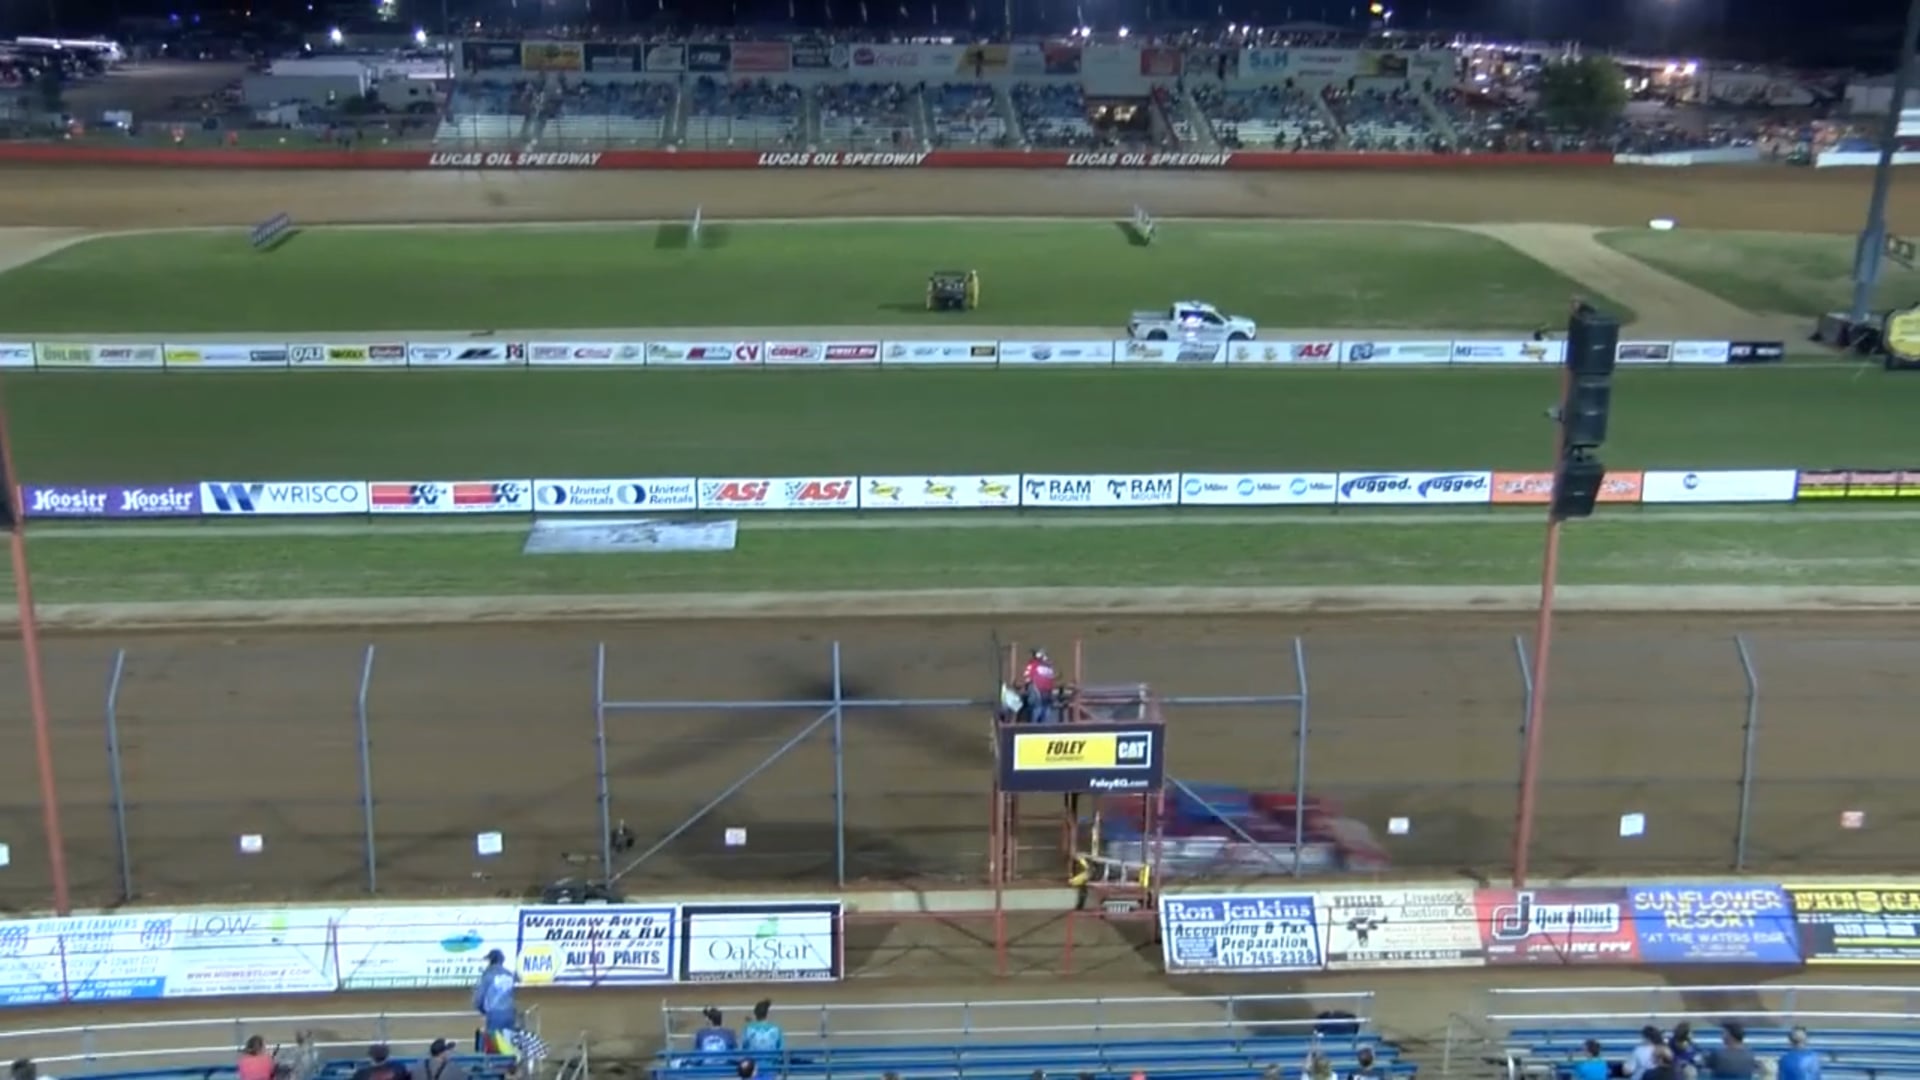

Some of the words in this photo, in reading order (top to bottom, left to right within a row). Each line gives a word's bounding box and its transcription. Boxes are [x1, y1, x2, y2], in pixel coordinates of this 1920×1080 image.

[429, 153, 482, 165] LUCAS
[486, 153, 512, 165] OIL
[517, 152, 601, 165] SPEEDWAY
[758, 153, 809, 165] LUCAS
[813, 153, 839, 165] OIL
[843, 152, 926, 165] SPEEDWAY
[1067, 153, 1118, 165] LUCAS
[1121, 153, 1145, 165] OIL
[1150, 153, 1231, 165] SPEEDWAY
[736, 345, 758, 360] CV
[268, 484, 359, 503] WRISCO
[570, 484, 611, 496] United
[649, 484, 689, 495] United
[1050, 480, 1092, 494] RAM
[1131, 479, 1172, 493] RAM
[33, 489, 107, 510] Hoosier
[121, 488, 193, 510] Hoosier
[570, 495, 614, 506] Rentals
[649, 494, 693, 505] Rentals
[1046, 741, 1086, 754] FOLEY
[1118, 741, 1146, 759] CAT
[1403, 892, 1465, 907] Livestock
[1634, 889, 1784, 911] SUNFLOWER
[1167, 902, 1214, 920] Ron
[1222, 899, 1311, 924] Jenkins
[1400, 906, 1449, 918] Auction
[1663, 909, 1758, 929] RESORT
[608, 915, 653, 927] AUTO
[1174, 924, 1259, 938] Accounting
[1264, 922, 1275, 934] &
[1280, 922, 1306, 934] Tax
[1668, 932, 1694, 943] THE
[708, 938, 811, 960] OakStar
[1221, 936, 1309, 952] Preparation
[523, 955, 553, 973] NAPA
[566, 950, 606, 966] AUTO
[613, 949, 660, 965] PARTS
